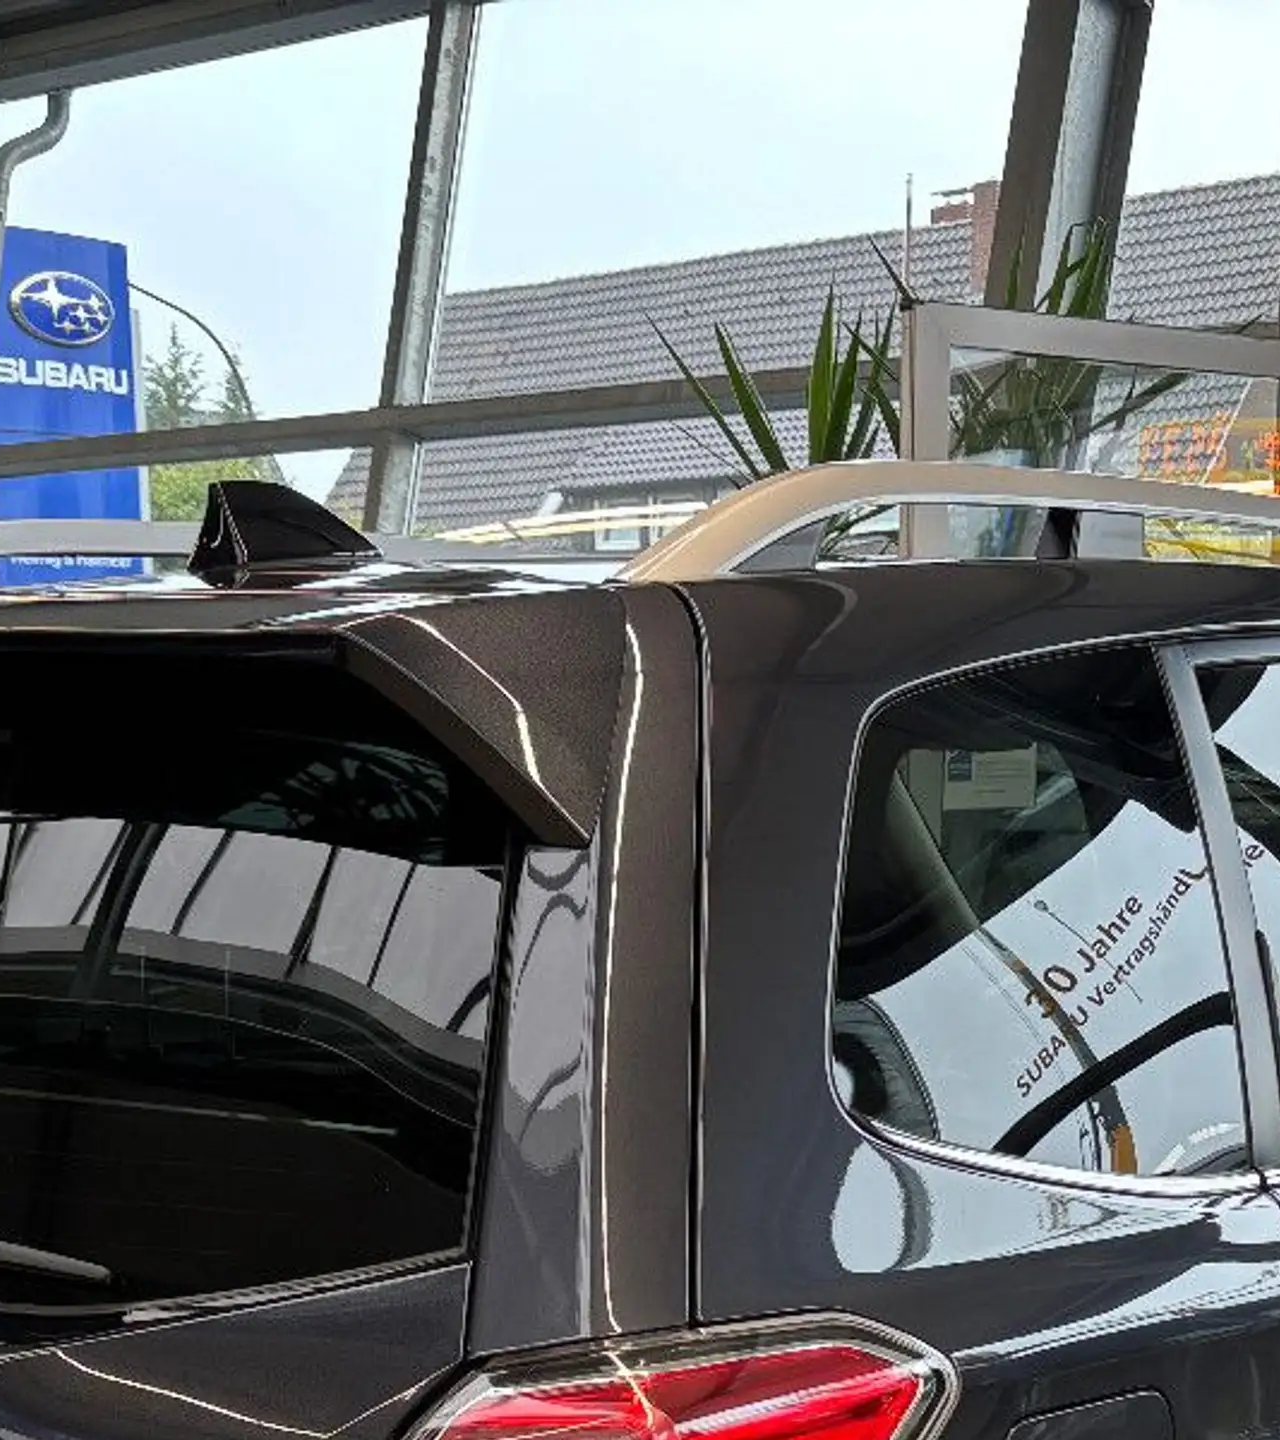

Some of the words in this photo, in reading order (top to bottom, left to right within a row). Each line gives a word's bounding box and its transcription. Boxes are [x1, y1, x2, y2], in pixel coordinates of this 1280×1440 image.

[1024, 964, 1078, 1019] 30
[1076, 894, 1144, 973] Jahre
[1016, 1004, 1089, 1098] SUBAU
